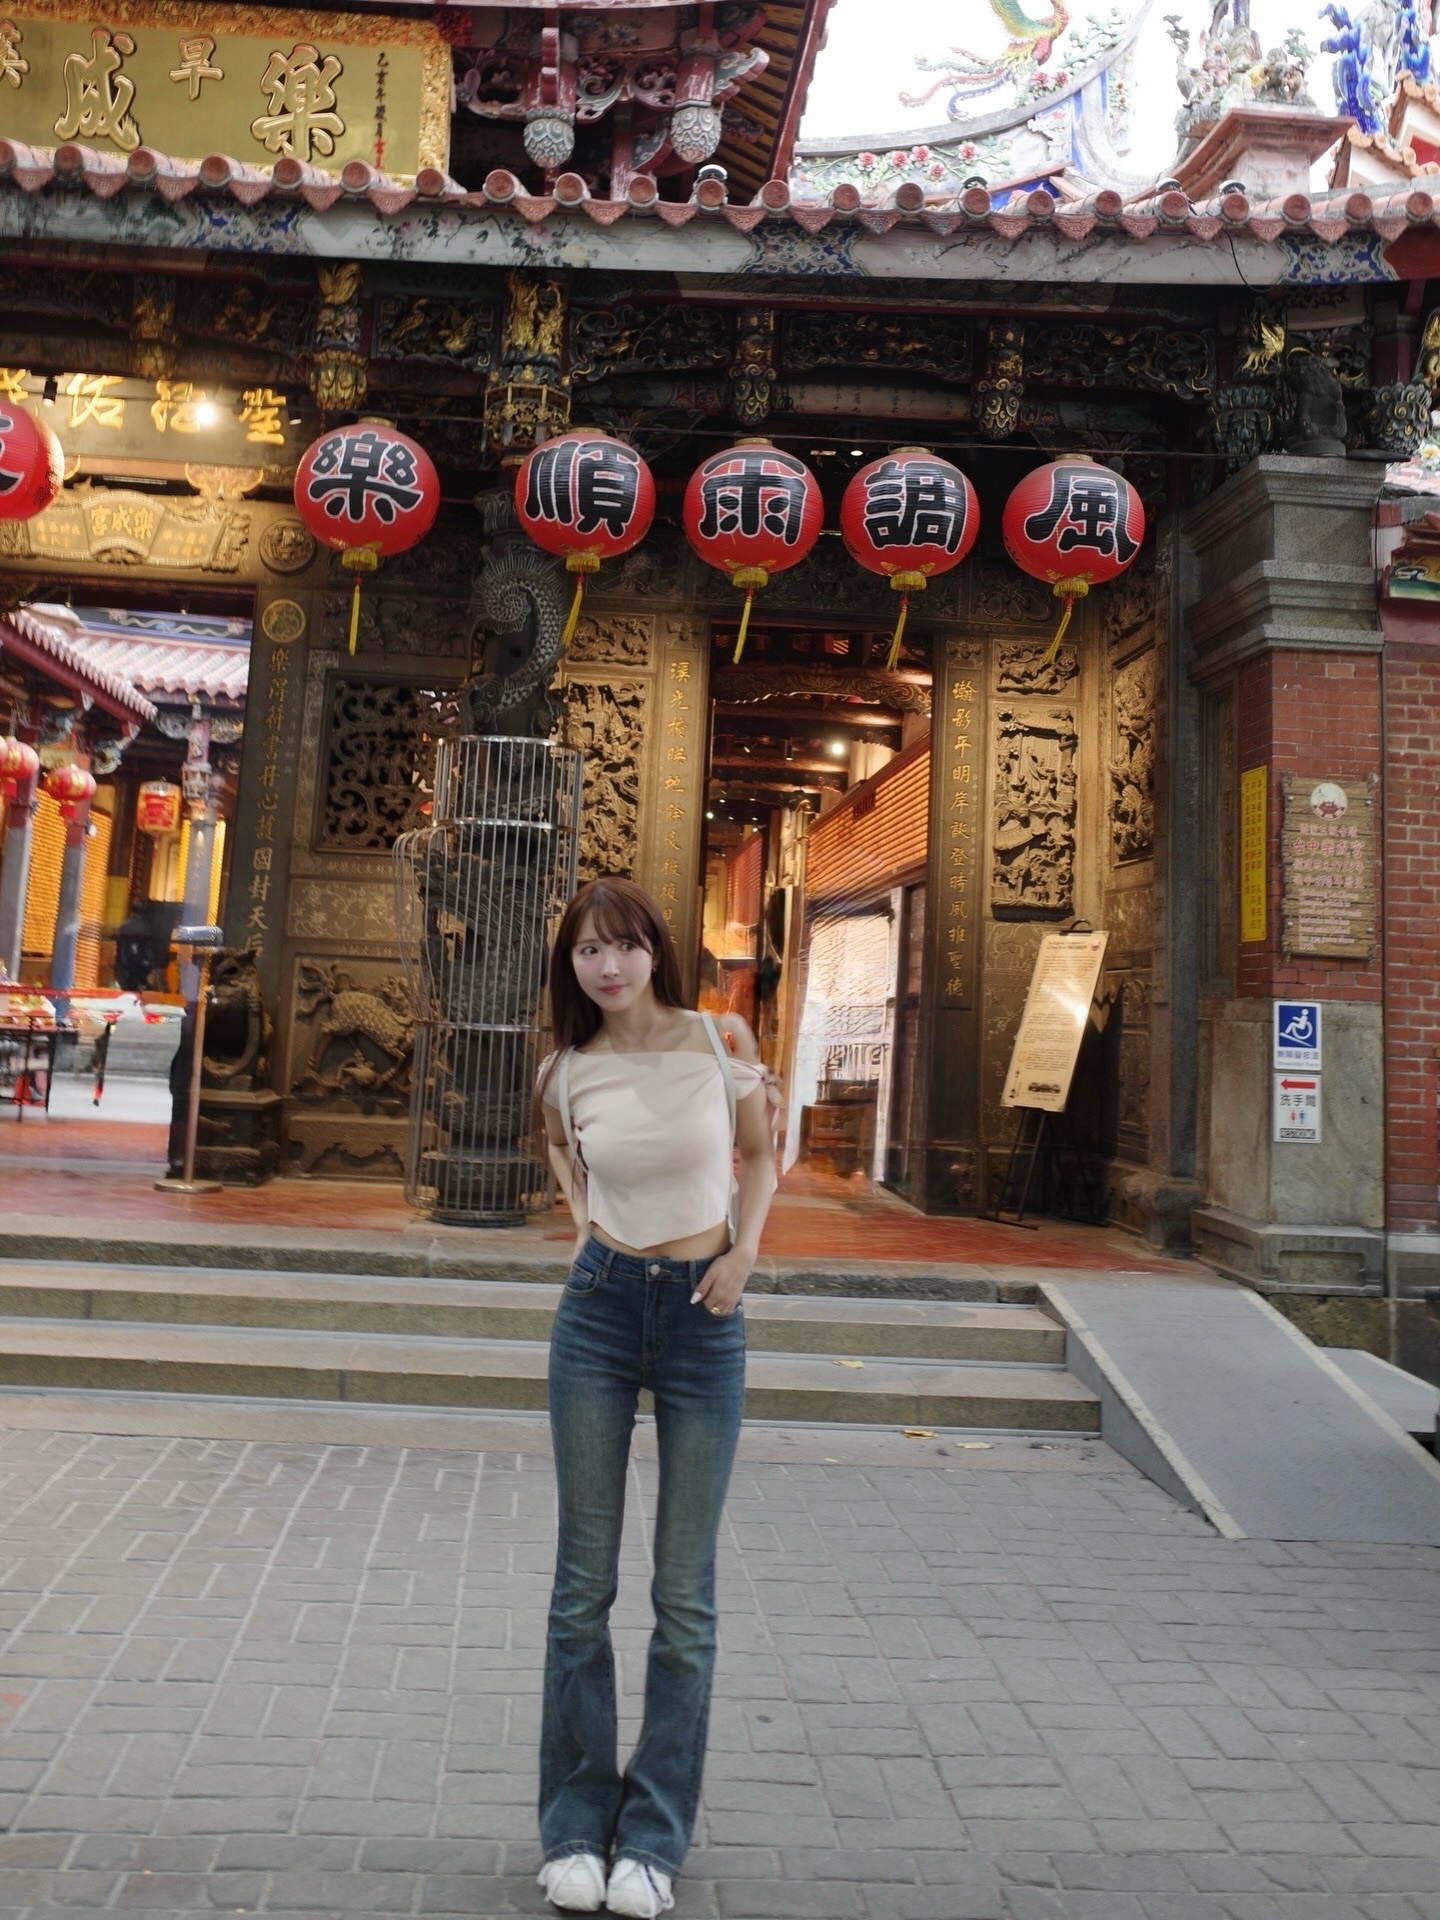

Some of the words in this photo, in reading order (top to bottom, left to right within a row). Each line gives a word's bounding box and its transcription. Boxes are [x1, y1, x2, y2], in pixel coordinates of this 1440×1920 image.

[308, 430, 424, 524] 樂
[524, 439, 641, 540] 順
[697, 449, 809, 546] 雨
[863, 460, 968, 555] 調
[1023, 464, 1140, 565] 風
[1279, 1094, 1317, 1107] 洗手間
